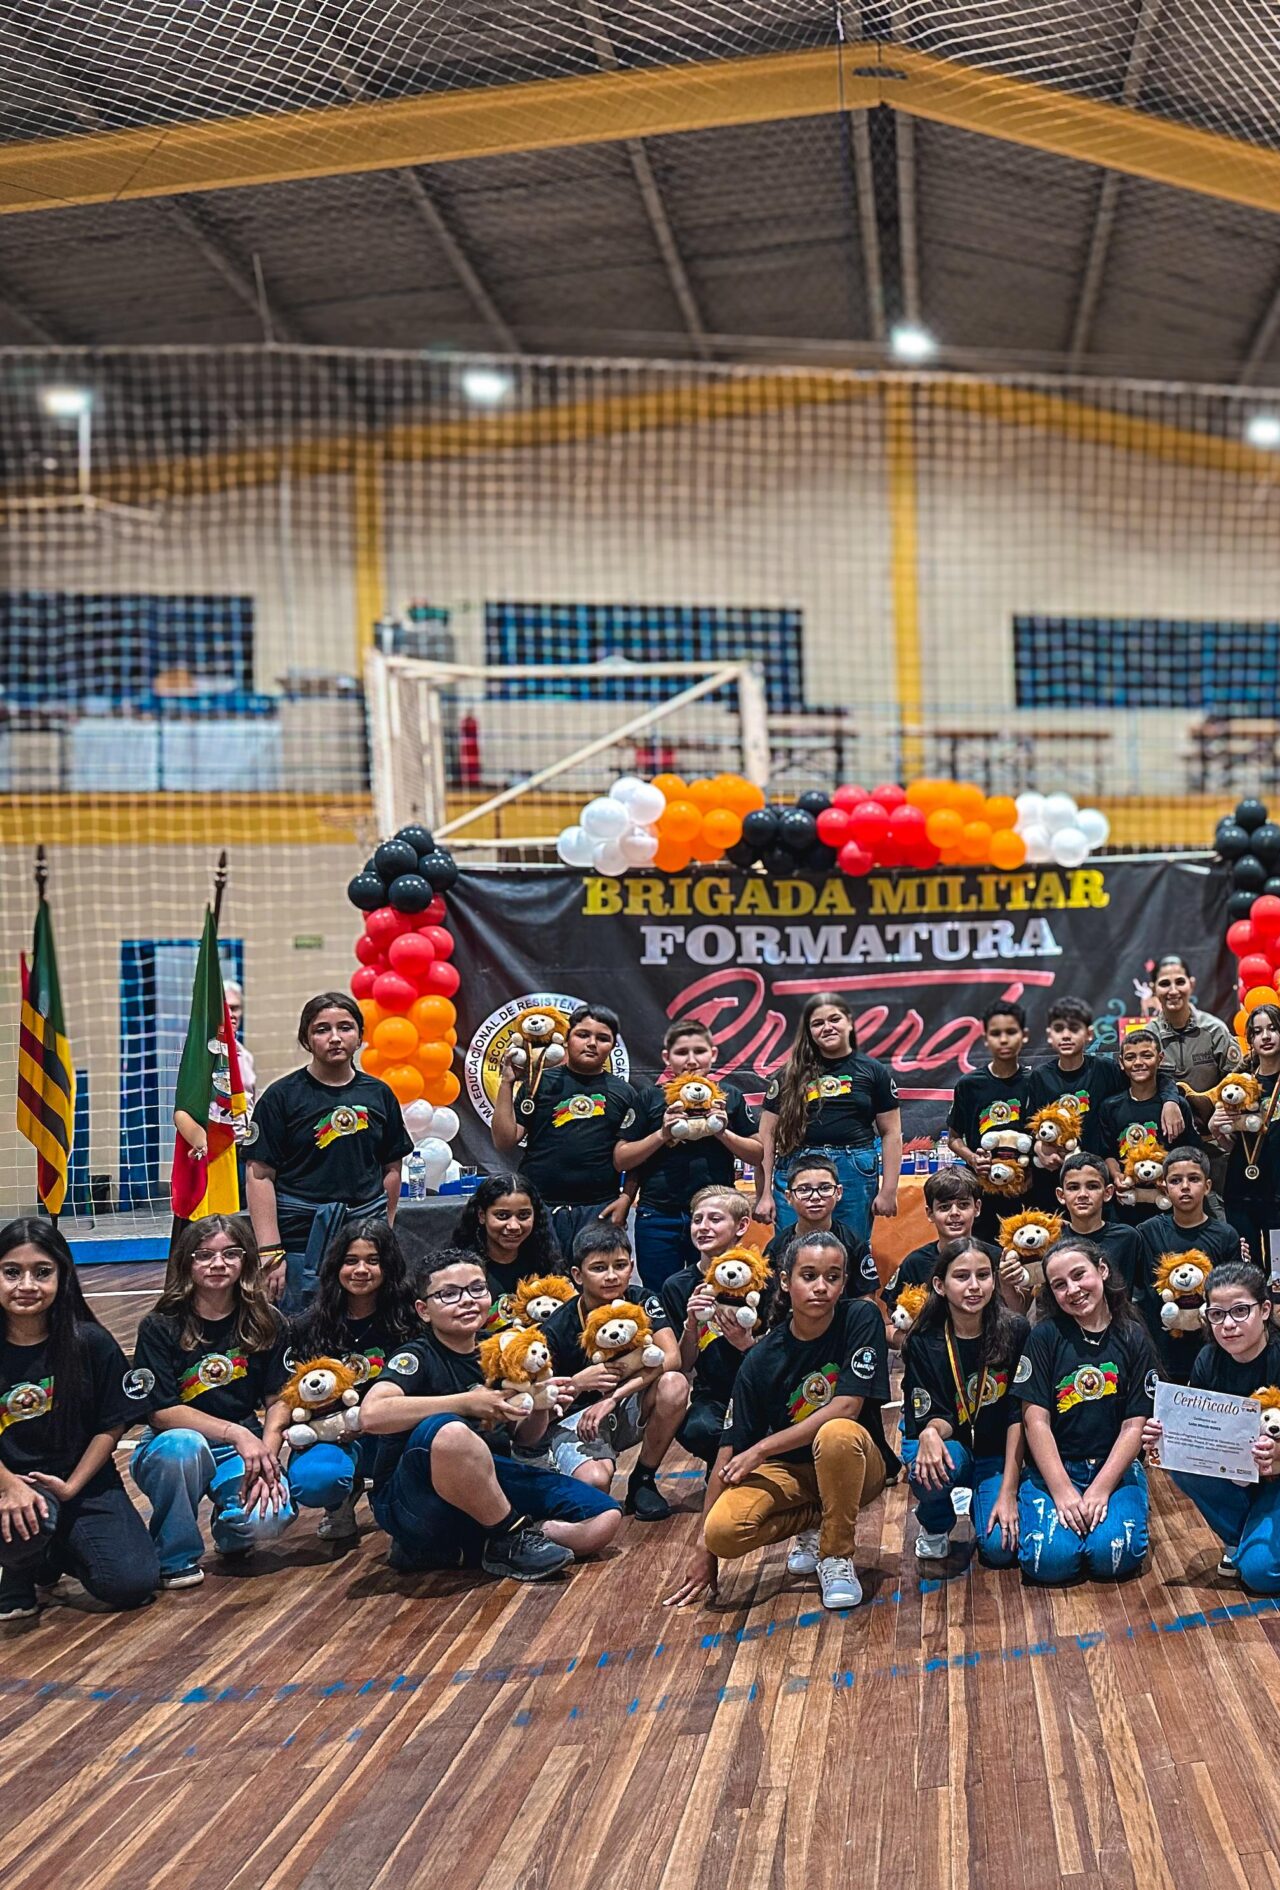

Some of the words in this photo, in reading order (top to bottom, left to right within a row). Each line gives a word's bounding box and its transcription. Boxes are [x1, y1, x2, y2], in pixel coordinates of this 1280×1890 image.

[581, 876, 857, 916] BRIGADA
[868, 869, 1110, 916] MILITAR
[640, 917, 1063, 965] FORMATURA
[468, 1020, 500, 1099] EDUCACIONAL
[499, 1006, 516, 1021] DE
[516, 998, 577, 1011] RESISTÊN
[656, 967, 1032, 1085] Prerd
[1174, 1391, 1240, 1415] Certificado
